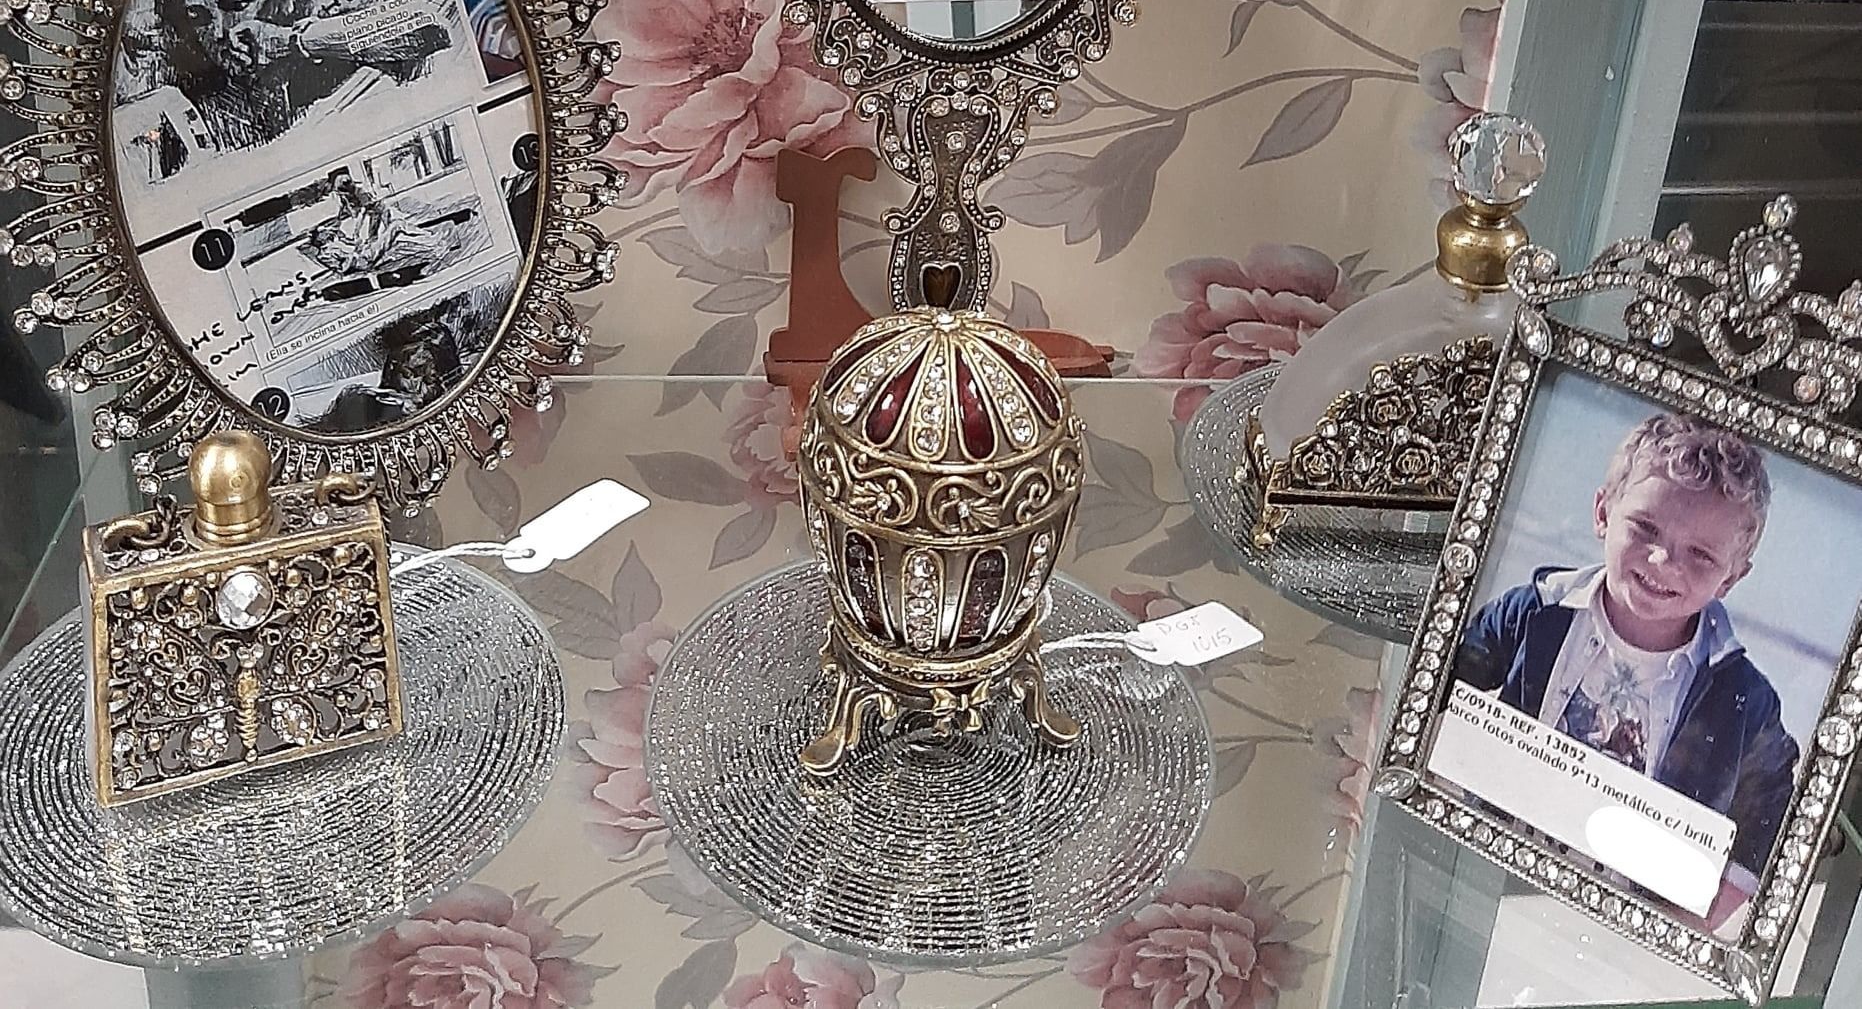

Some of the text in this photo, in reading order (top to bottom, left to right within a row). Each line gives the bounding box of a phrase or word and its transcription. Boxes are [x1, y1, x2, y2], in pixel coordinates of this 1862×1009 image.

[201, 238, 225, 262] 11
[204, 332, 255, 370] OWN
[258, 395, 285, 417] 12
[1483, 719, 1514, 745] fotos
[1517, 739, 1567, 772] ovalado
[1602, 784, 1662, 822] metálico
[1684, 824, 1717, 851] brill.
